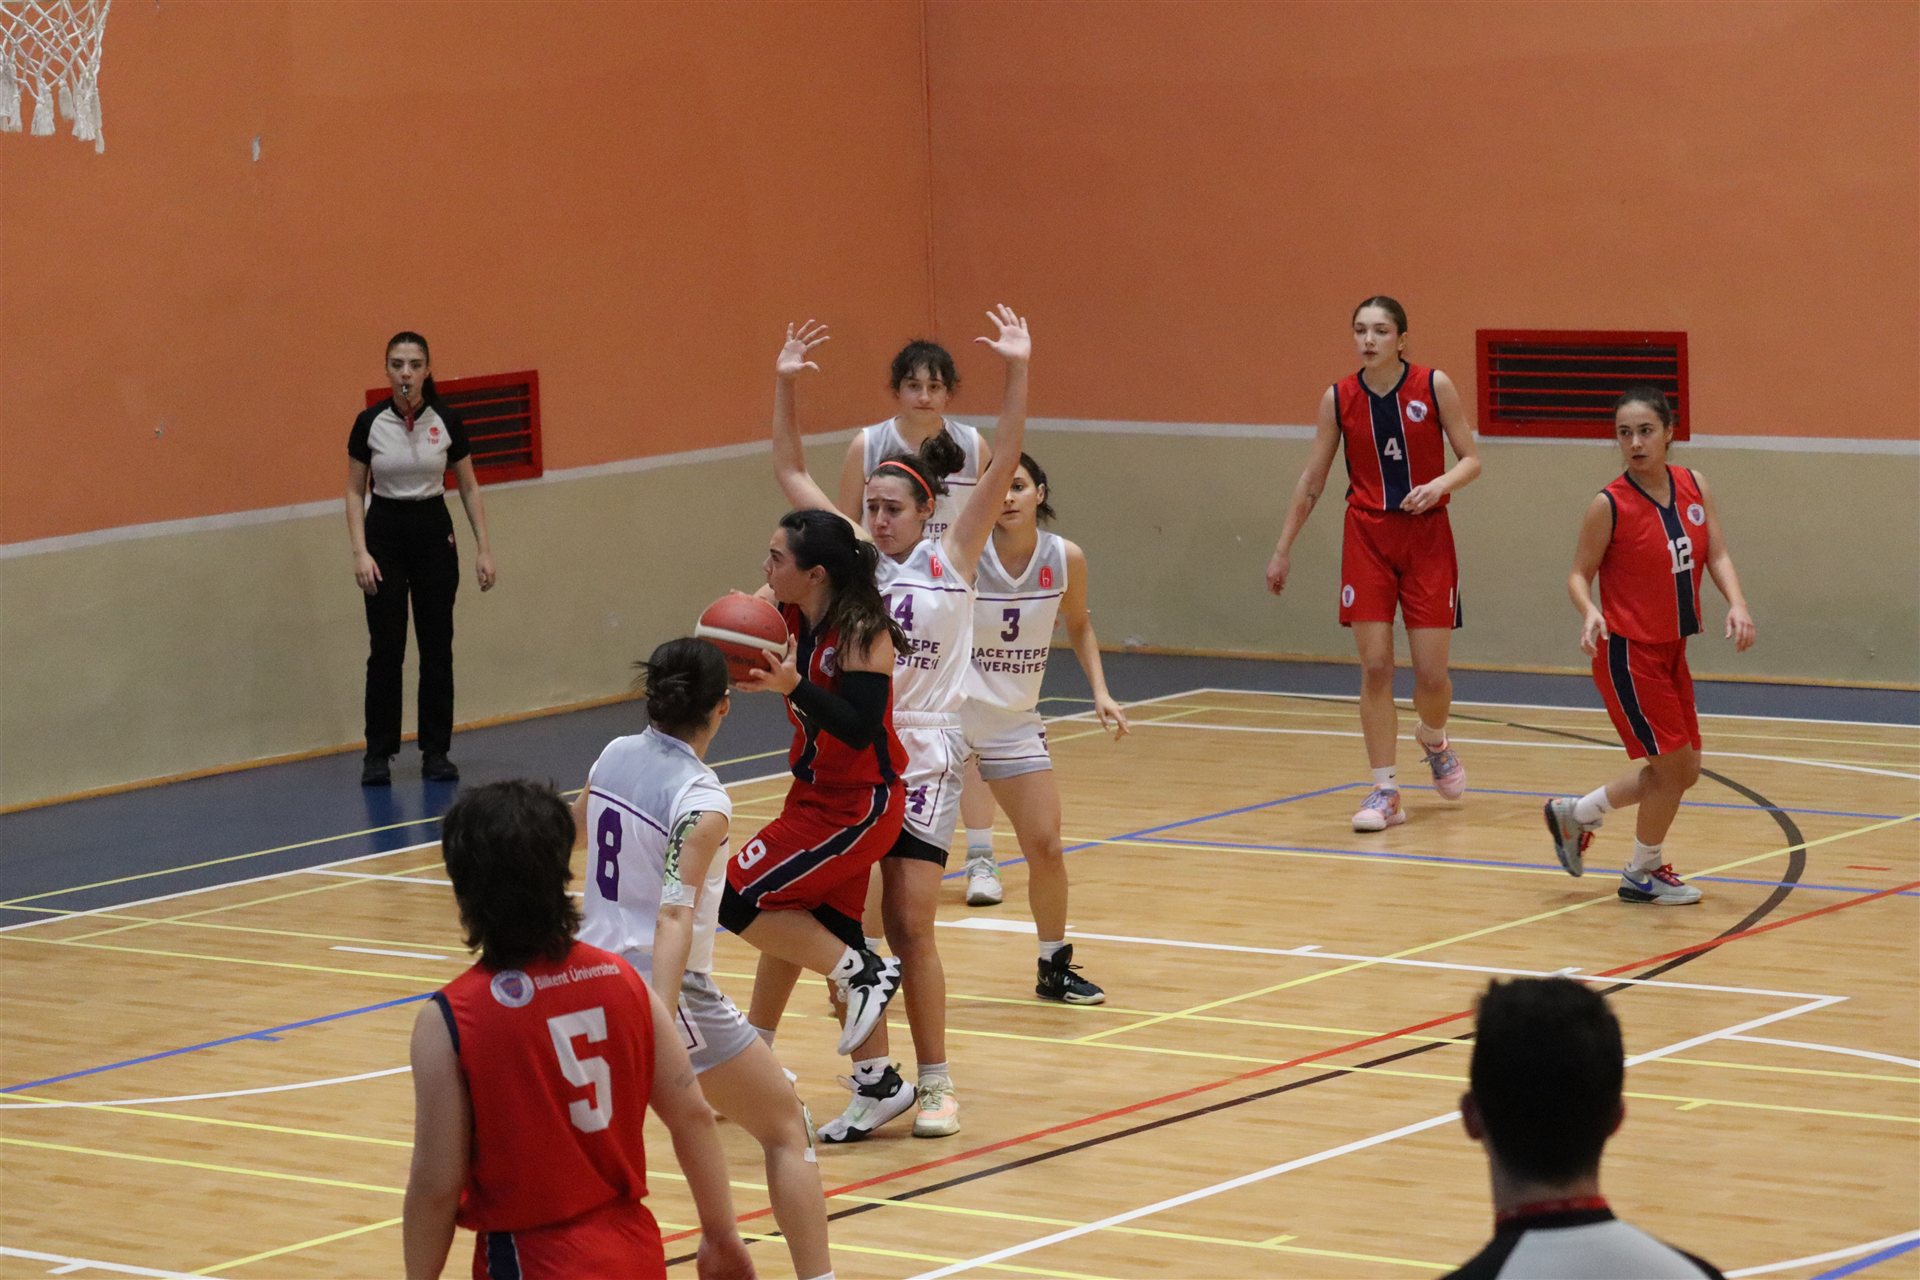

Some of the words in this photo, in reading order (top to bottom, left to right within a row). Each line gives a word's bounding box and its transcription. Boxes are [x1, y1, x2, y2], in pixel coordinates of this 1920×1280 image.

[1384, 438, 1402, 460] 4
[1667, 536, 1694, 574] 12
[1001, 608, 1020, 642] 3
[596, 806, 622, 902] 8
[737, 838, 767, 870] 9
[534, 972, 570, 990] Bilkent
[546, 1006, 613, 1134] 5
